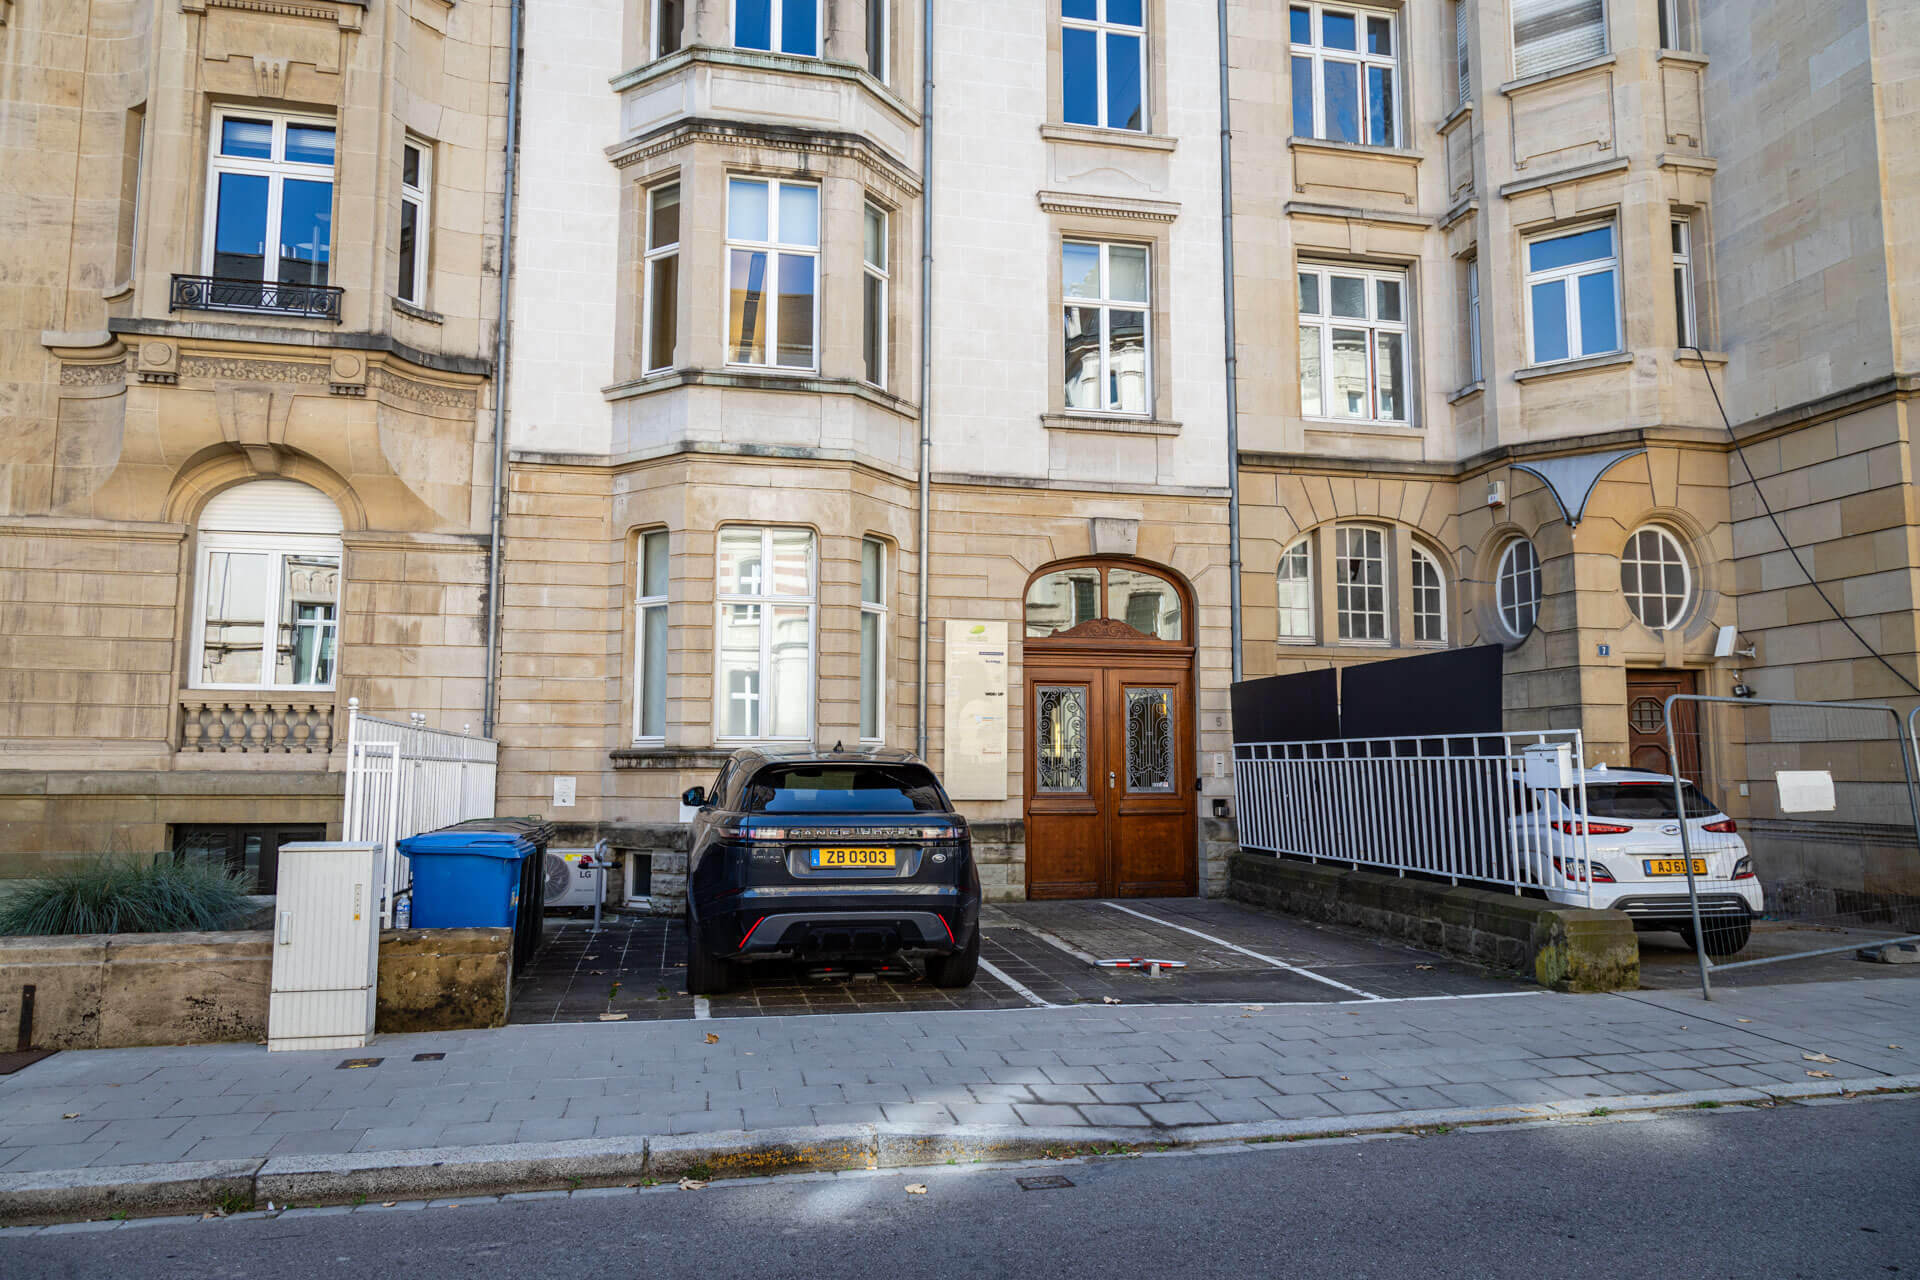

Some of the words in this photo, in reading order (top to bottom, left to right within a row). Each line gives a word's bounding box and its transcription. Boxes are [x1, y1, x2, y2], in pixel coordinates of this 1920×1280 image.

[1215, 716, 1223, 727] 5
[826, 850, 845, 863] ZB
[849, 850, 887, 863] 0303
[1658, 862, 1672, 873] AJ
[1673, 861, 1700, 872] 616
[580, 871, 592, 879] LG
